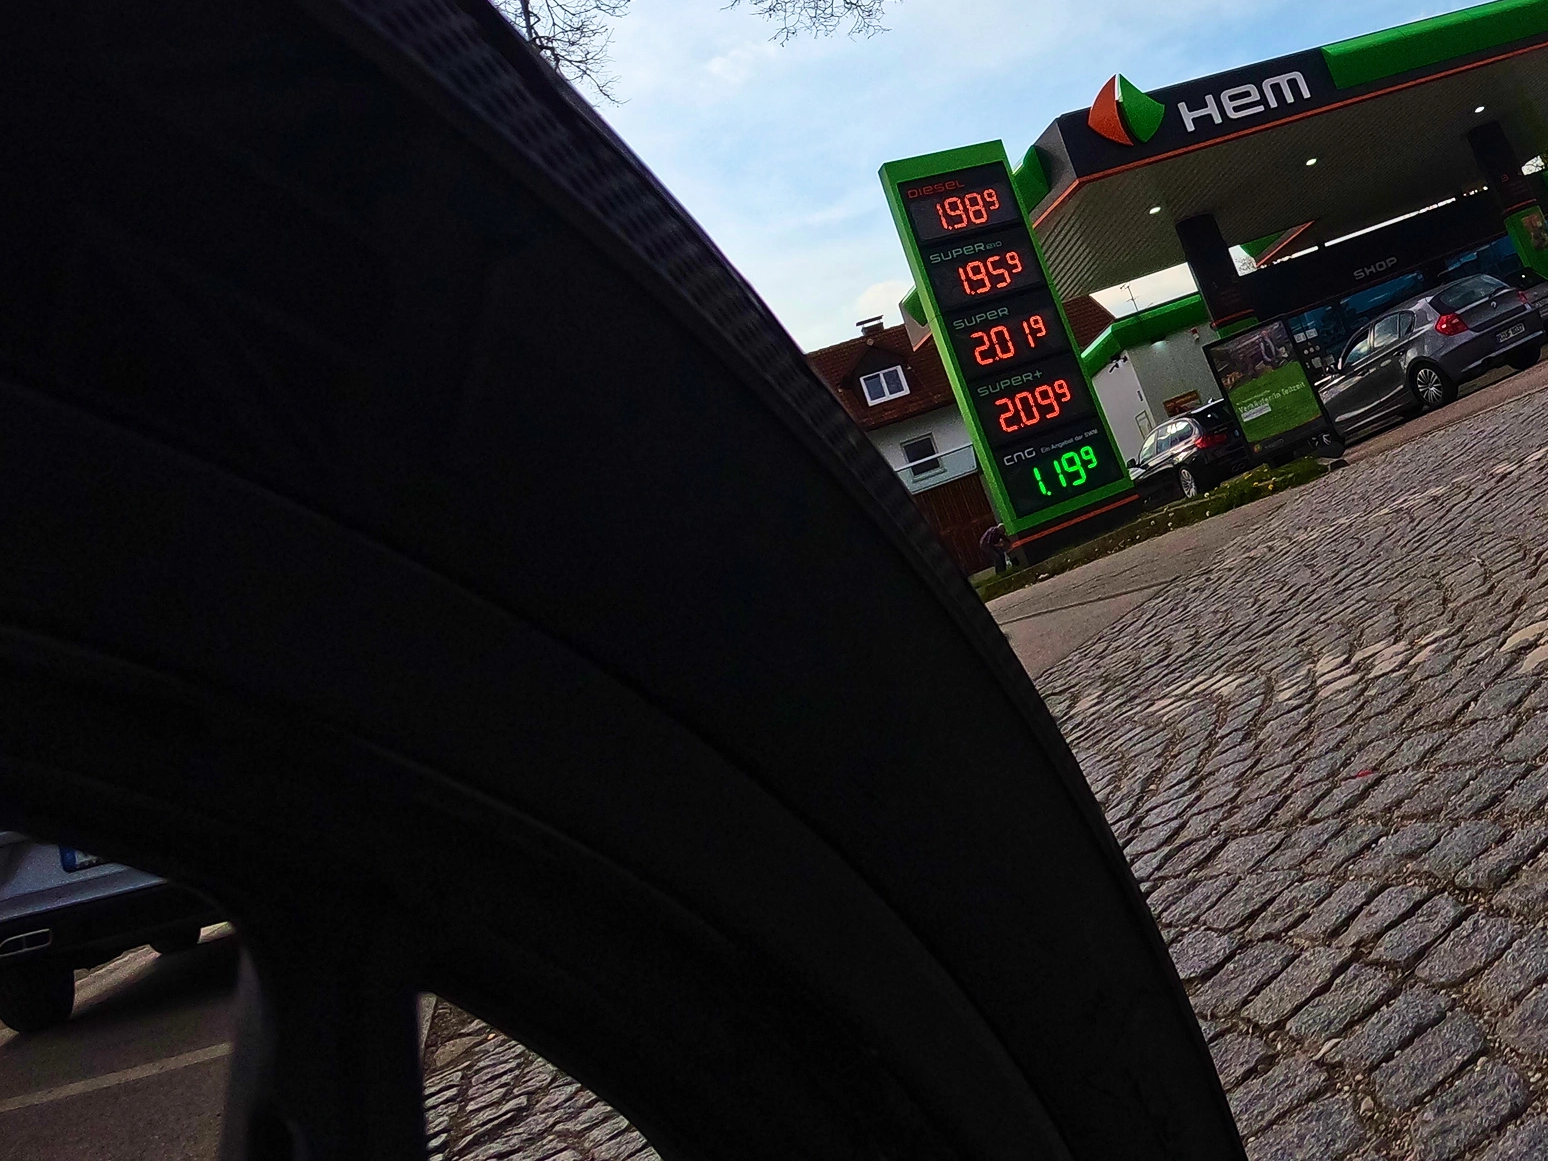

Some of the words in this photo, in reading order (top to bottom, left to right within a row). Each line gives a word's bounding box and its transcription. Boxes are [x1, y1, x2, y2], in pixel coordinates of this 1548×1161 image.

[1177, 71, 1312, 132] HEM
[929, 242, 986, 264] SUPER
[1352, 256, 1398, 280] SHOP
[952, 307, 1010, 330] SUPER
[977, 370, 1043, 397] SUPER+
[1003, 447, 1036, 466] CNG
